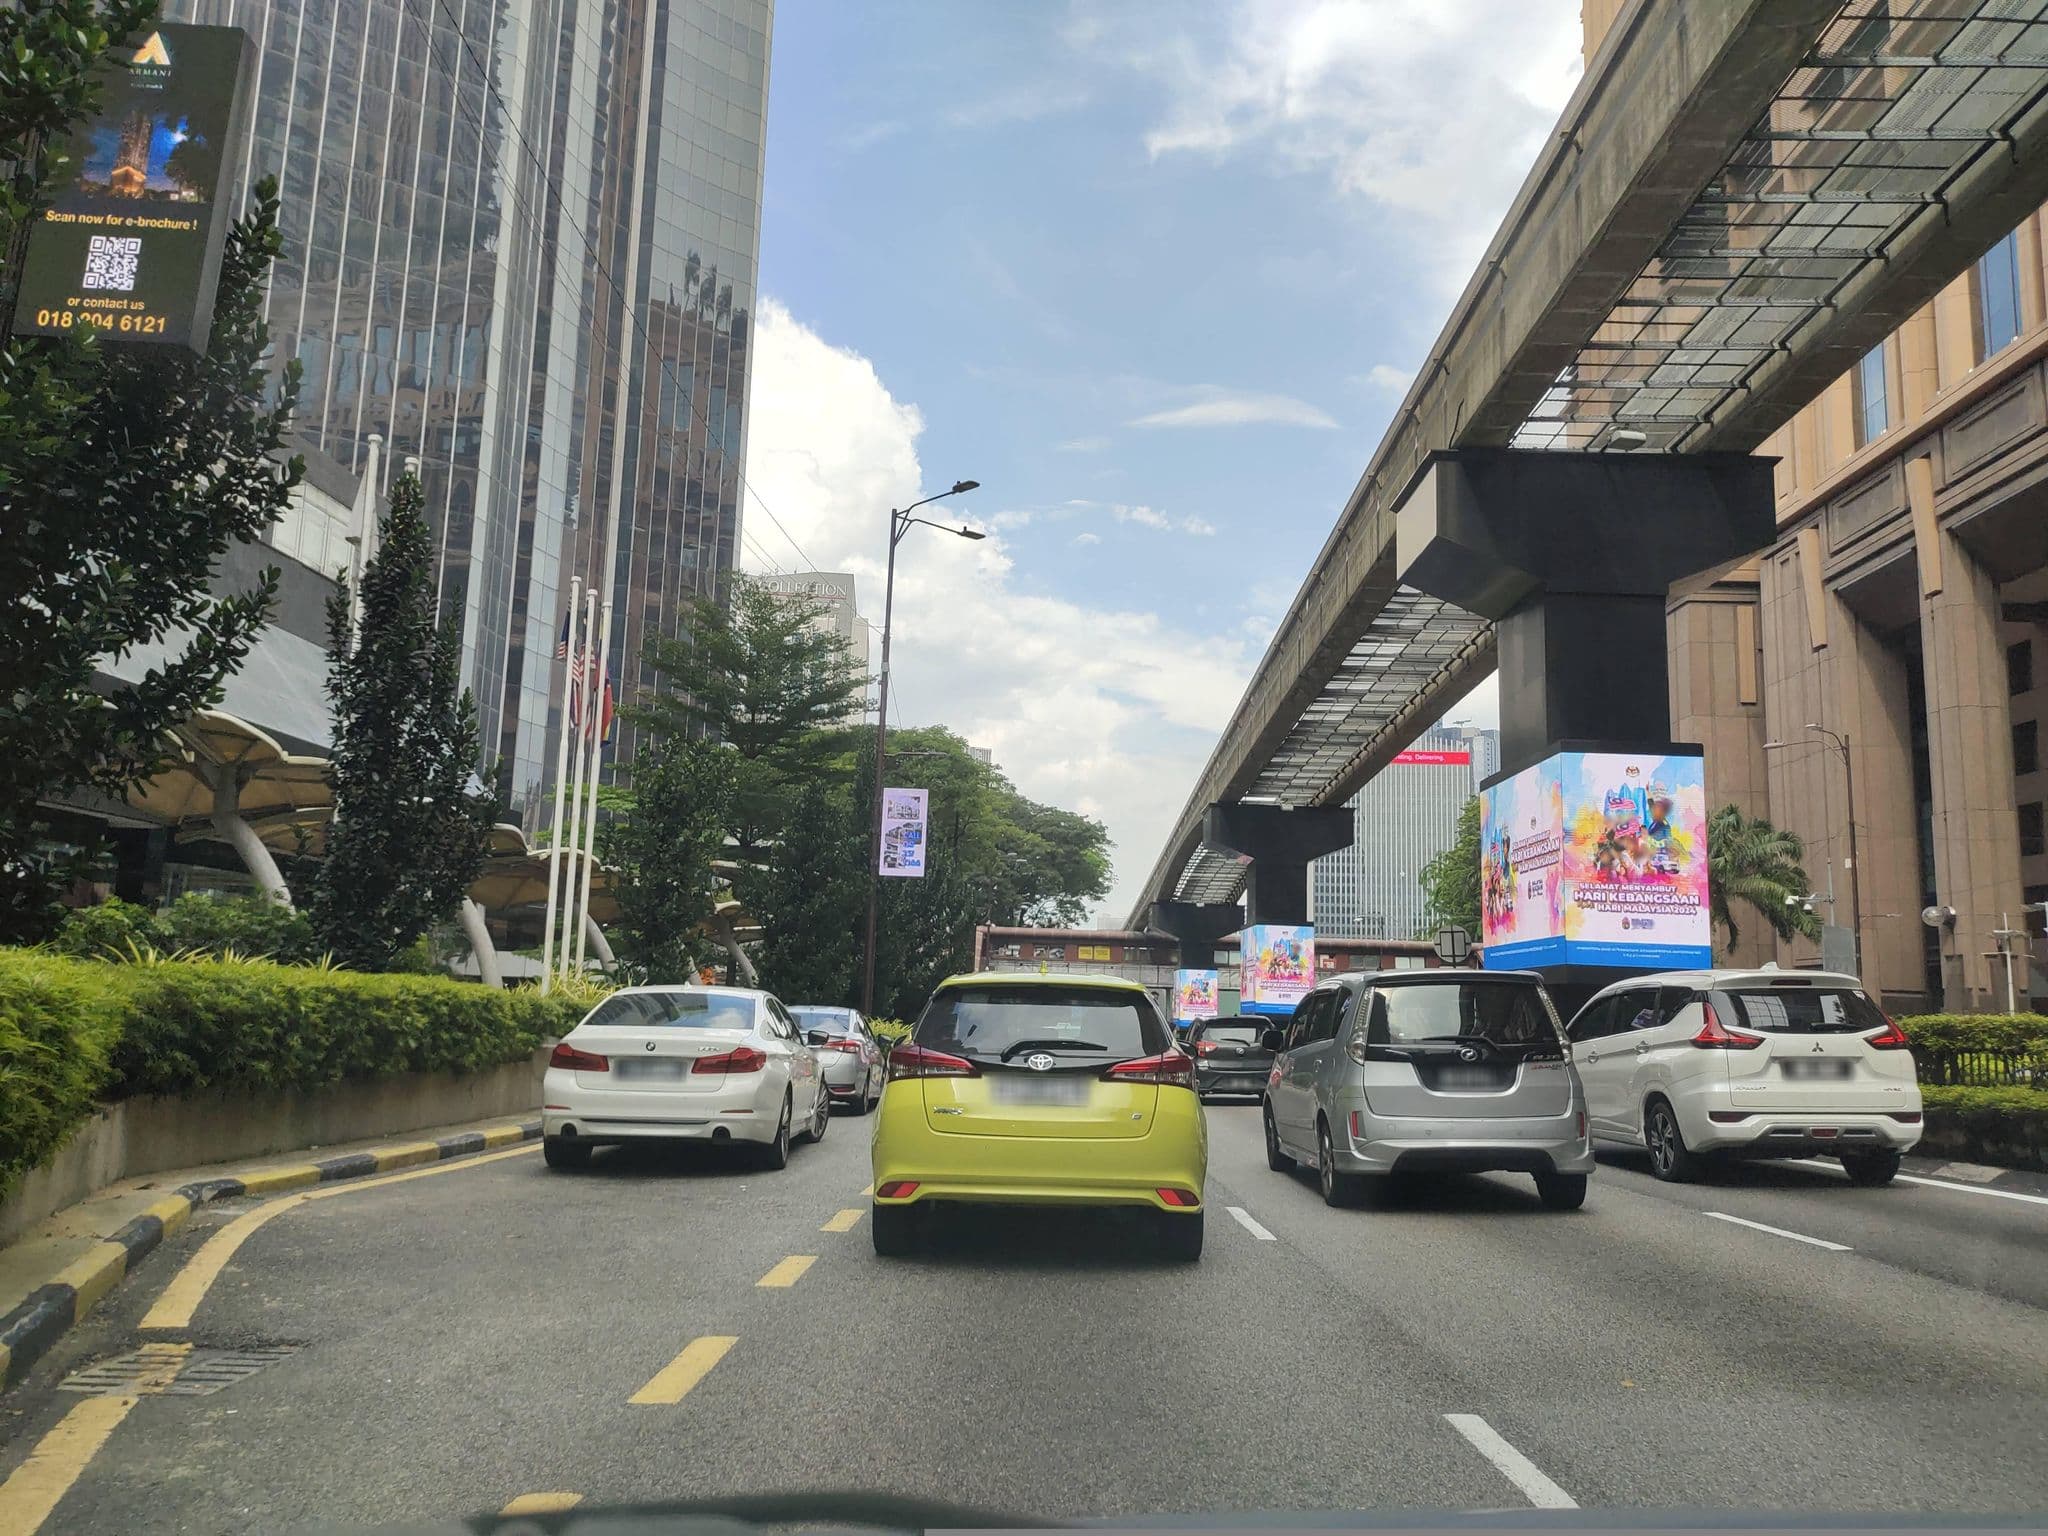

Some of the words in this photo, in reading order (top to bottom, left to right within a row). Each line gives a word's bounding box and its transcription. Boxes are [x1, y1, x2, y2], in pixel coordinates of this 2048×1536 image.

[46, 210, 76, 223] Scan
[78, 214, 104, 224] now
[106, 214, 124, 226] for
[125, 216, 191, 231] e-brochure
[67, 297, 80, 306] or
[83, 297, 127, 310] contact
[130, 302, 145, 311] us
[37, 309, 73, 328] 018
[119, 315, 166, 333] 6121
[1579, 883, 1620, 891] SELAMAT
[1621, 885, 1677, 893] MENYAMBUT
[1573, 890, 1606, 902] HARI
[1609, 892, 1701, 906] KEBANGSAAN
[1598, 902, 1621, 912] HARI
[1622, 904, 1672, 914] MALAYSIA
[1673, 905, 1697, 915] 2024
